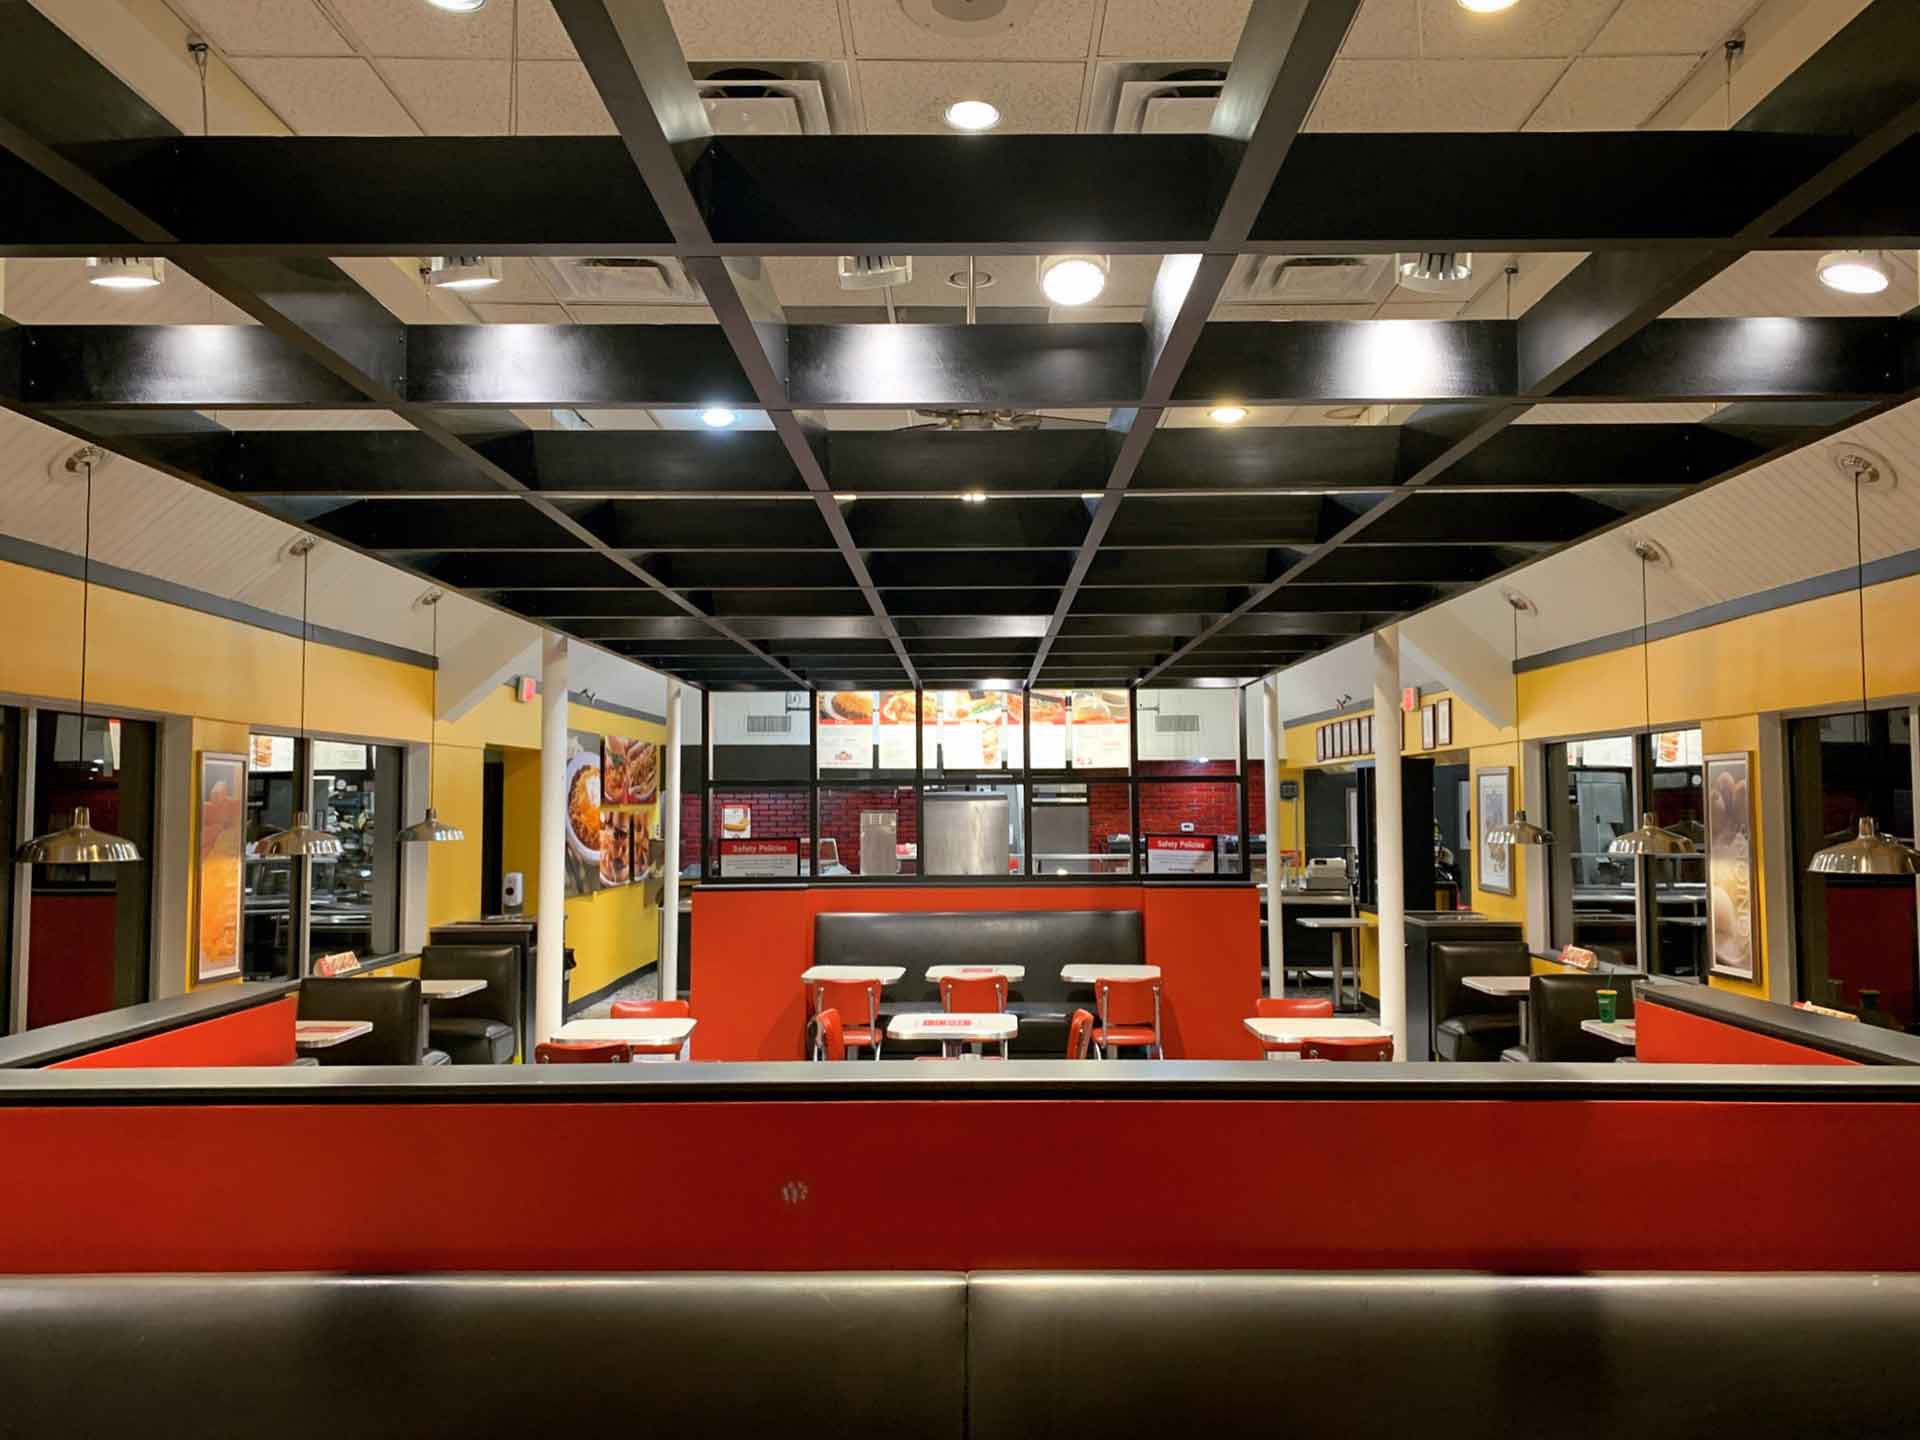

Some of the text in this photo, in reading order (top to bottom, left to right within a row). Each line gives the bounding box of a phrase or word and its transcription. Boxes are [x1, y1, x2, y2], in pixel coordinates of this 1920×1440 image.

[732, 844, 787, 853] Safety Policies
[1157, 840, 1205, 849] Safety Policies
